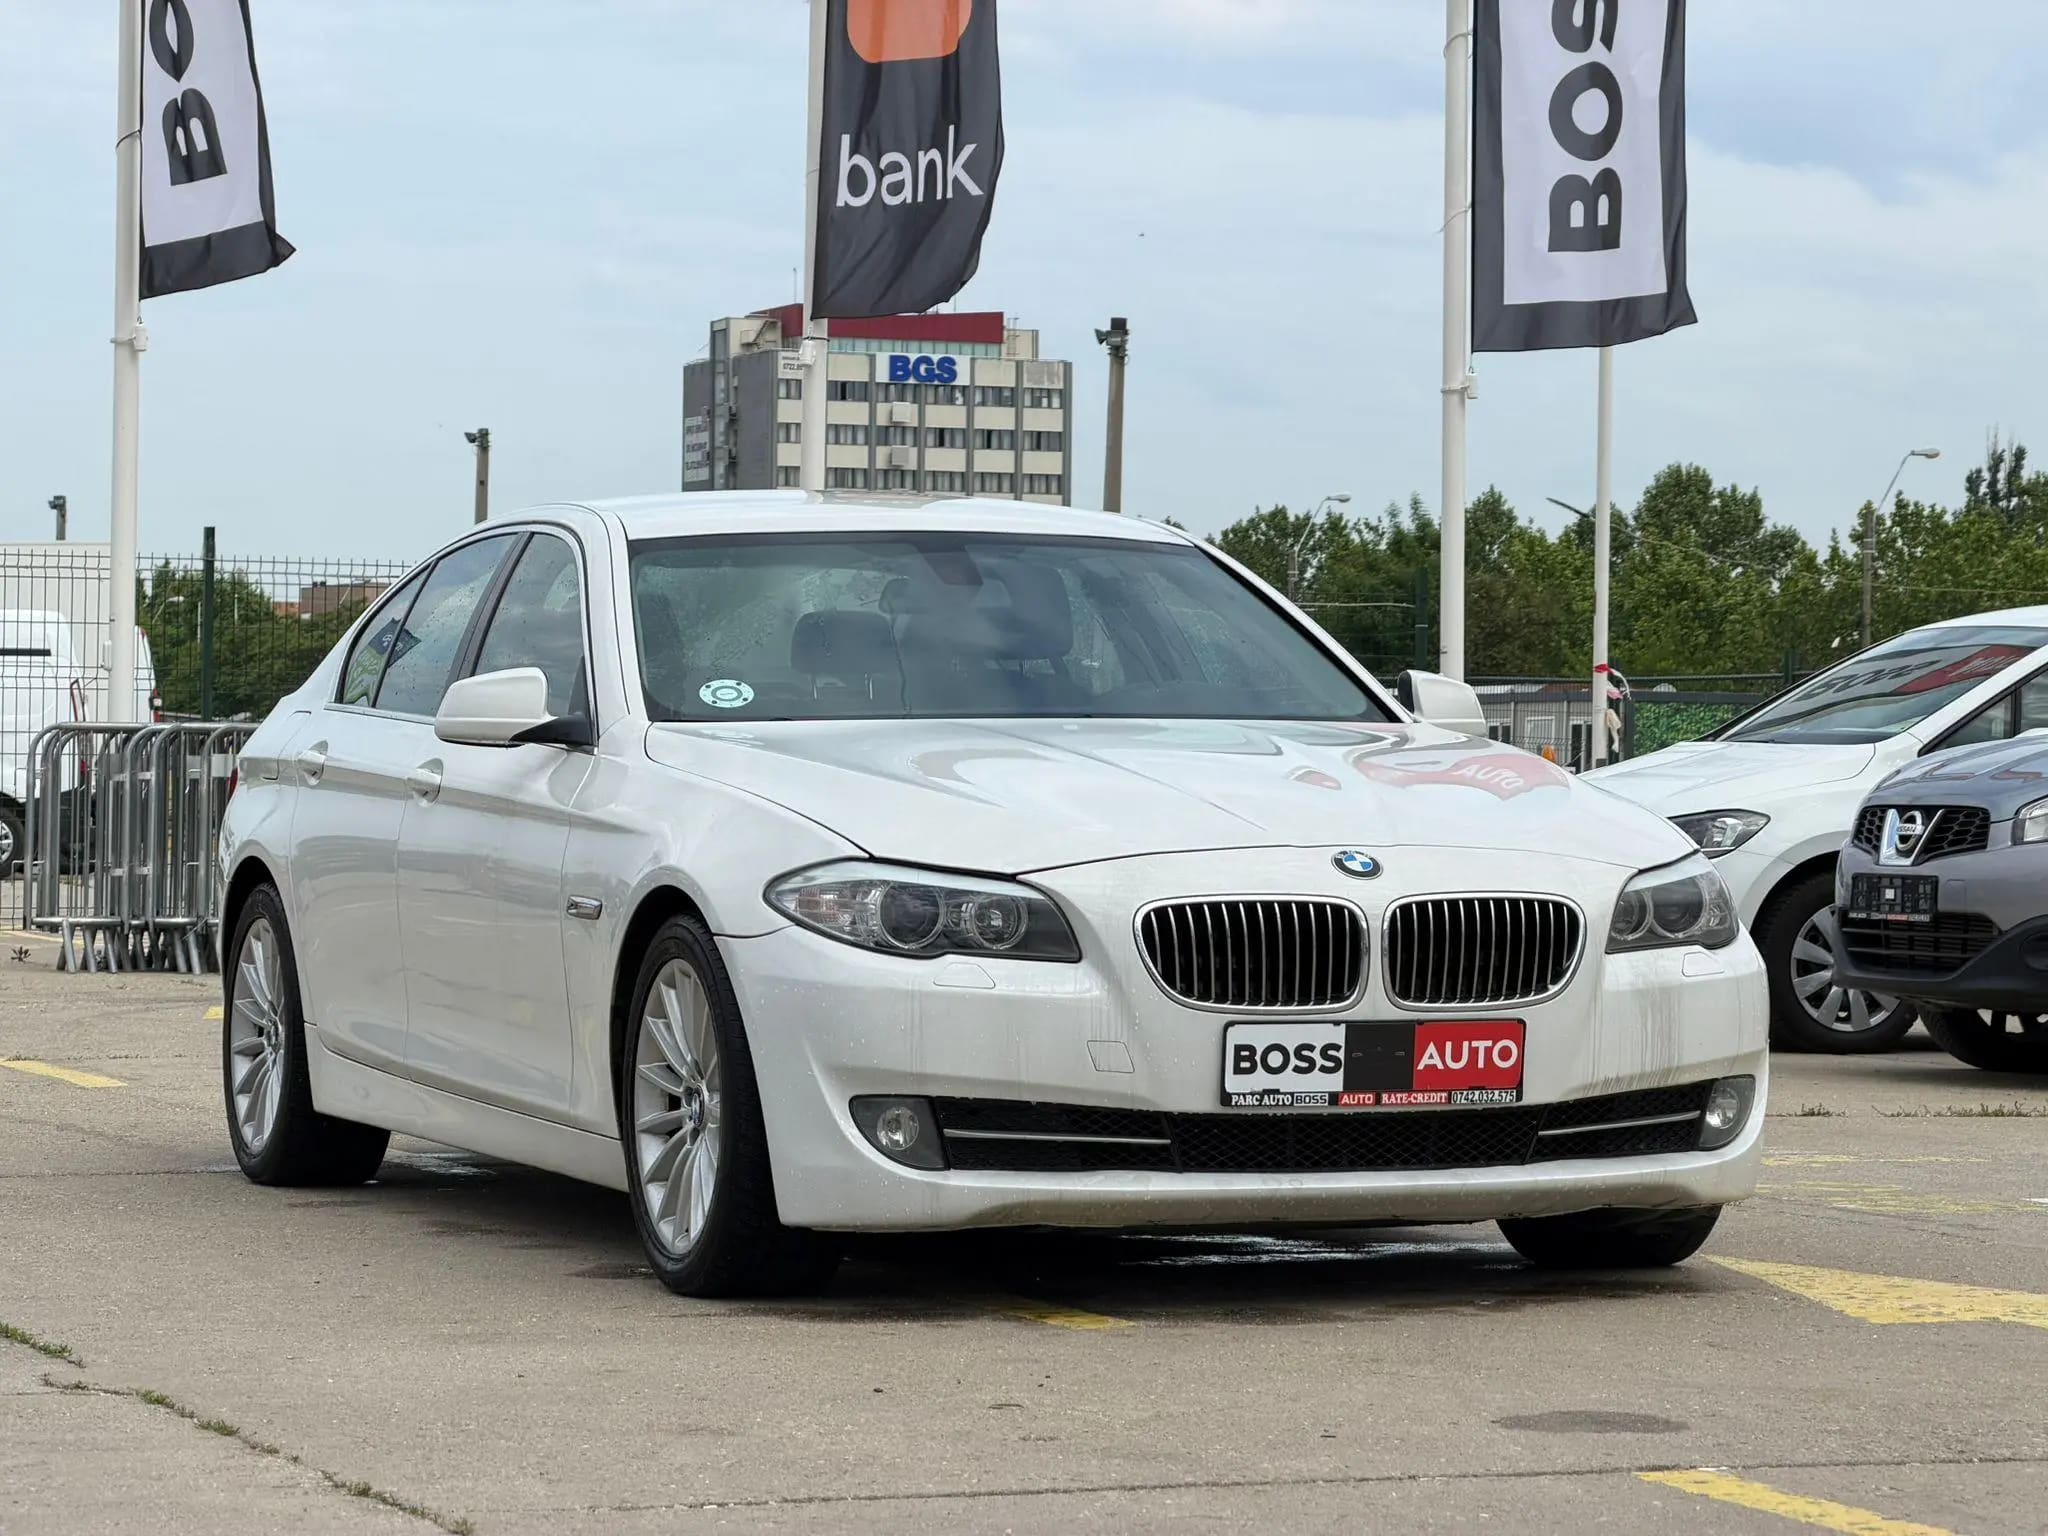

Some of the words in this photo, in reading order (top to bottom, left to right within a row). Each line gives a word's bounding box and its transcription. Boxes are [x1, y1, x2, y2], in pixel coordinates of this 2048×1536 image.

[835, 125, 985, 208] bank
[889, 355, 957, 383] BGS
[1233, 1043, 1343, 1075] BOSS
[1417, 1039, 1519, 1071] AUTO
[1231, 1094, 1260, 1105] PARC
[1261, 1094, 1292, 1105] AUTO
[1294, 1094, 1328, 1105] BOSS
[1341, 1093, 1374, 1104] AUTO
[1381, 1092, 1447, 1104] RATE-CREDIT
